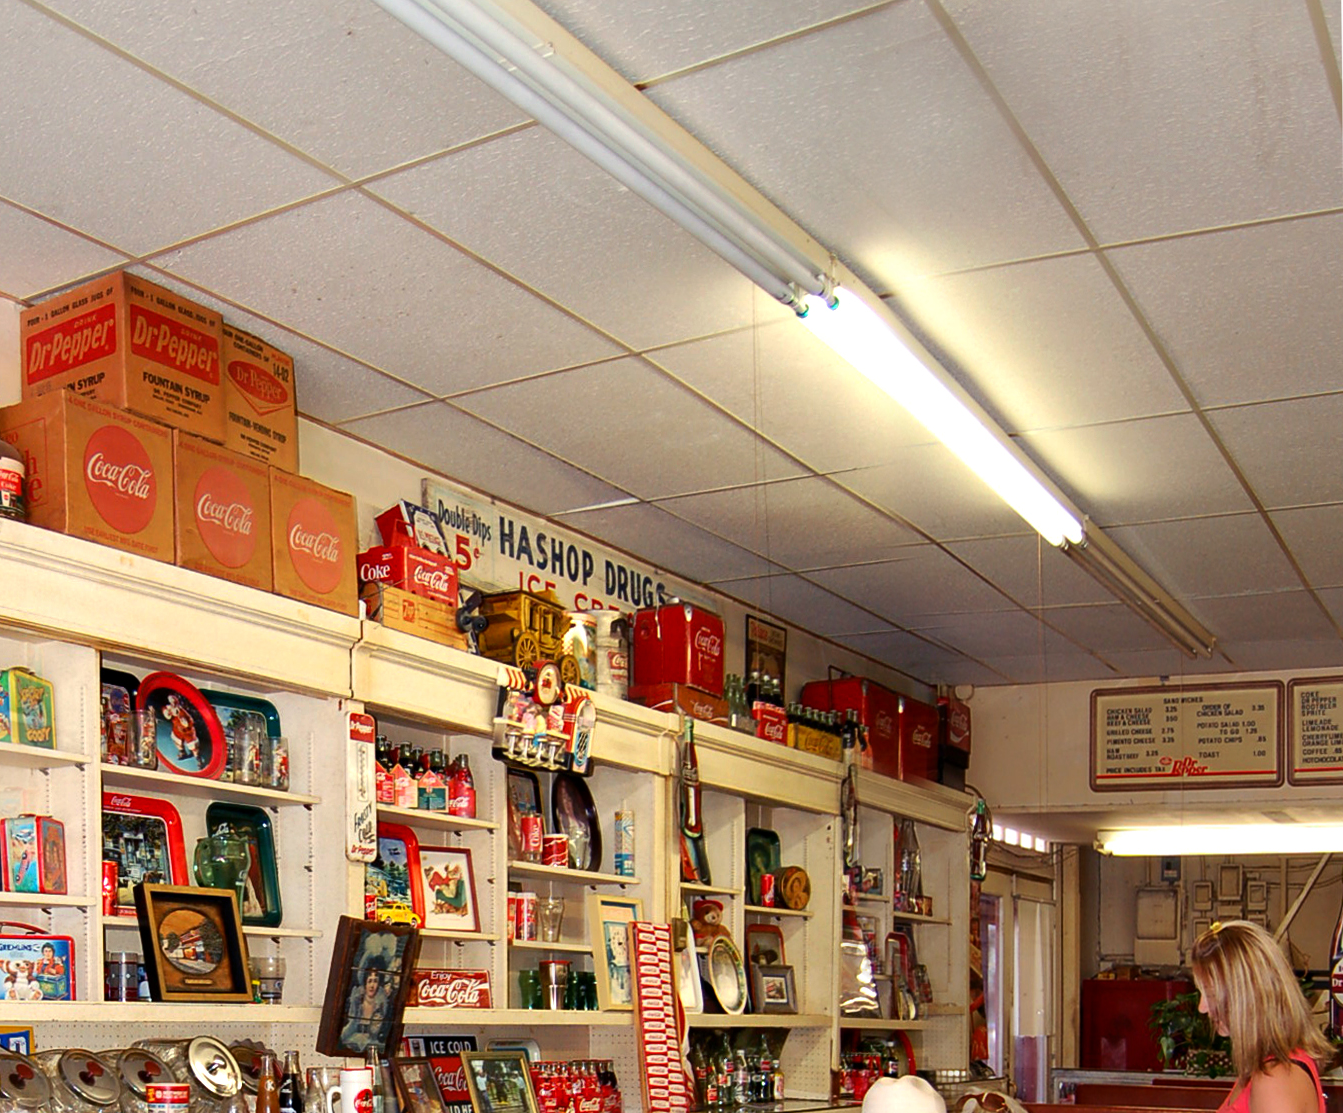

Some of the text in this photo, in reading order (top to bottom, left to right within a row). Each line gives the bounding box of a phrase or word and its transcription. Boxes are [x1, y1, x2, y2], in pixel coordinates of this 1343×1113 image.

[106, 287, 113, 296] OF
[49, 321, 109, 366] Pepper
[156, 324, 217, 372] Pepper
[77, 372, 105, 391] SYRUP
[143, 371, 183, 395] FOUNTAIN
[185, 386, 210, 405] SYRUP
[250, 369, 281, 401] Pepper
[87, 452, 152, 499] Coca-Cola
[197, 493, 253, 535] Coca-Cola
[438, 499, 471, 535] Double
[472, 513, 492, 547] Dips
[290, 523, 340, 562] Coca-Cola
[360, 563, 391, 582] Coke
[499, 516, 594, 587] HASHOP
[604, 560, 666, 608] DRUGS
[414, 564, 449, 593] Coca-Cola
[694, 630, 721, 657] Coca-Cola
[26, 726, 51, 742] GOOFY
[764, 722, 784, 740] Coca-Cola
[111, 795, 132, 807] Coca-Cola
[430, 971, 451, 981] Enjoy
[418, 978, 481, 1006] Coca-Cola
[430, 1040, 472, 1054] ICE COLD
[579, 1097, 601, 1112] Coca-Cola
